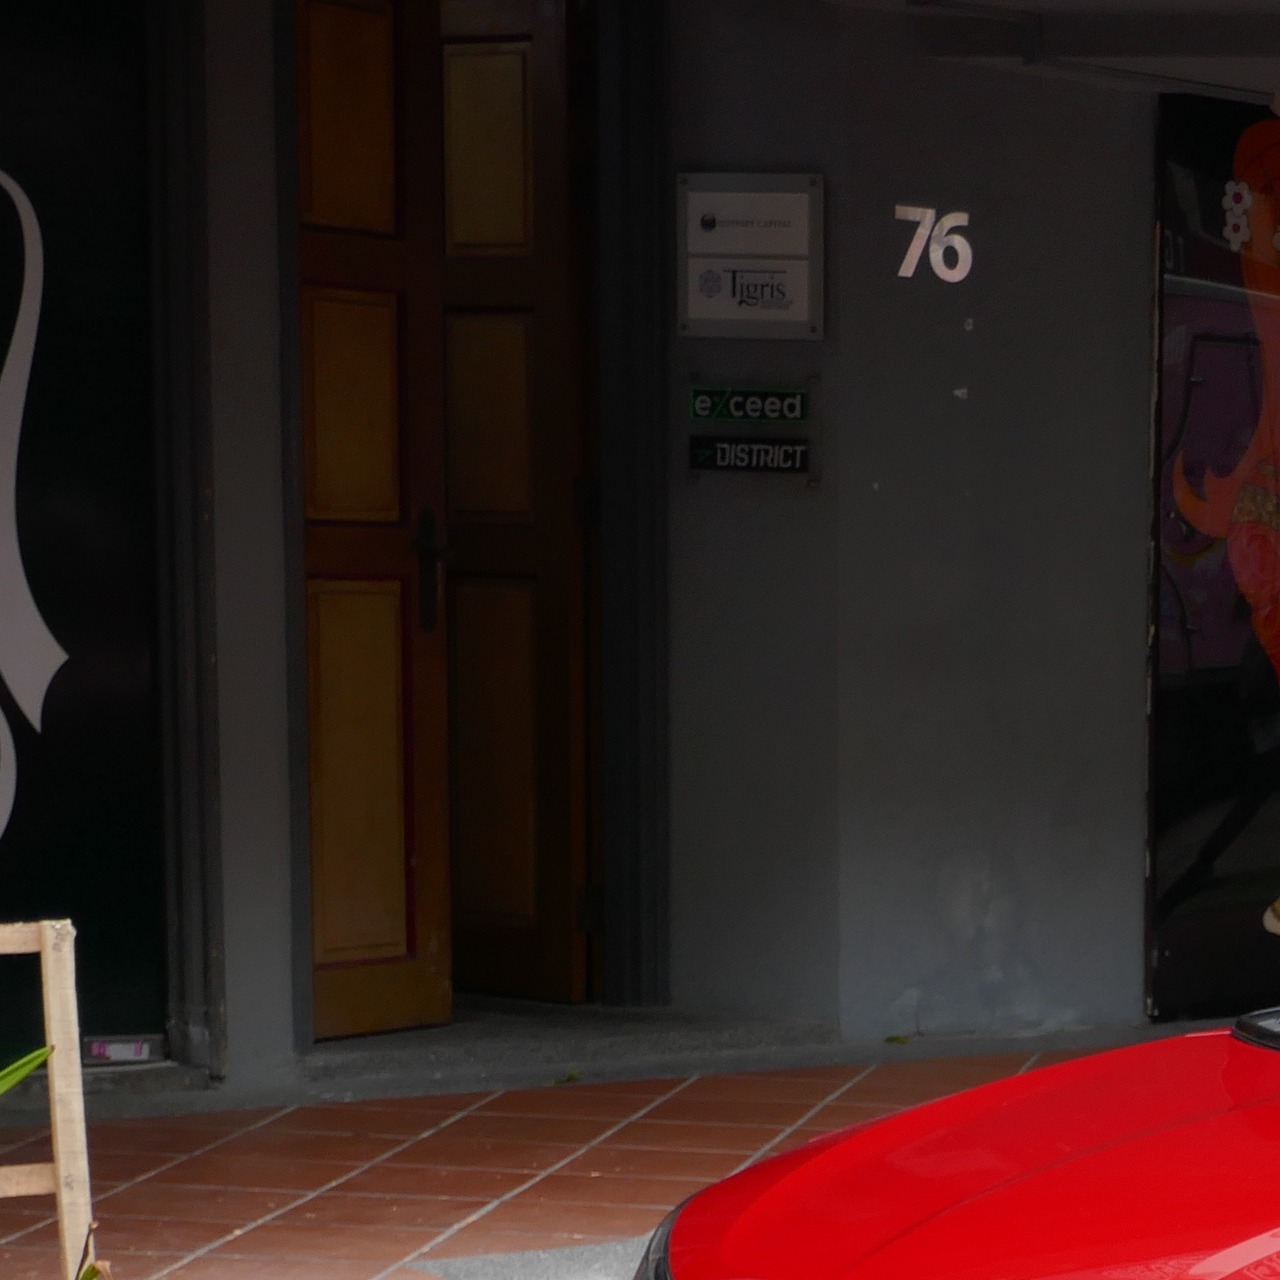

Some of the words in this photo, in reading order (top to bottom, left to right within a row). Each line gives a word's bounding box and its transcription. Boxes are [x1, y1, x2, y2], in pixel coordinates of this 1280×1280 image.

[894, 204, 974, 283] 76
[723, 270, 787, 307] Tigris
[716, 442, 806, 469] DISTRICT
